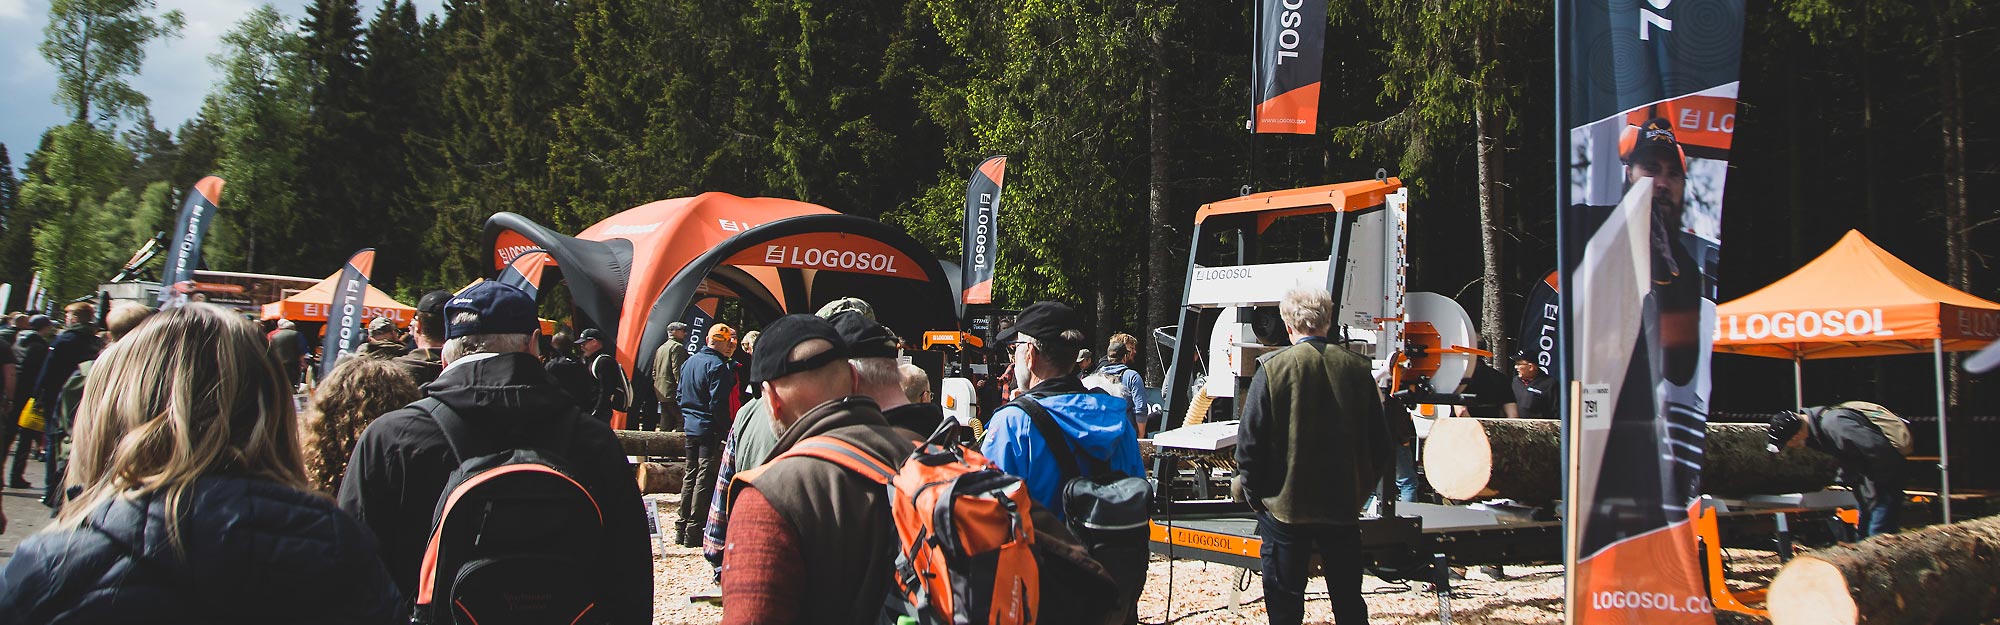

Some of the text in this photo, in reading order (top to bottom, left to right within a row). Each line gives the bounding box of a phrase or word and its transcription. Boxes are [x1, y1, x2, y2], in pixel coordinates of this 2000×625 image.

[175, 217, 200, 274] LOGOSOL
[974, 207, 990, 272] LOGOSOL
[791, 246, 897, 273] LOGOSOL
[1206, 268, 1252, 281] LOGOSOL
[1728, 308, 1895, 341] LOGOSOL
[1584, 400, 1598, 413] 791
[1188, 532, 1233, 550] LOGOSOL
